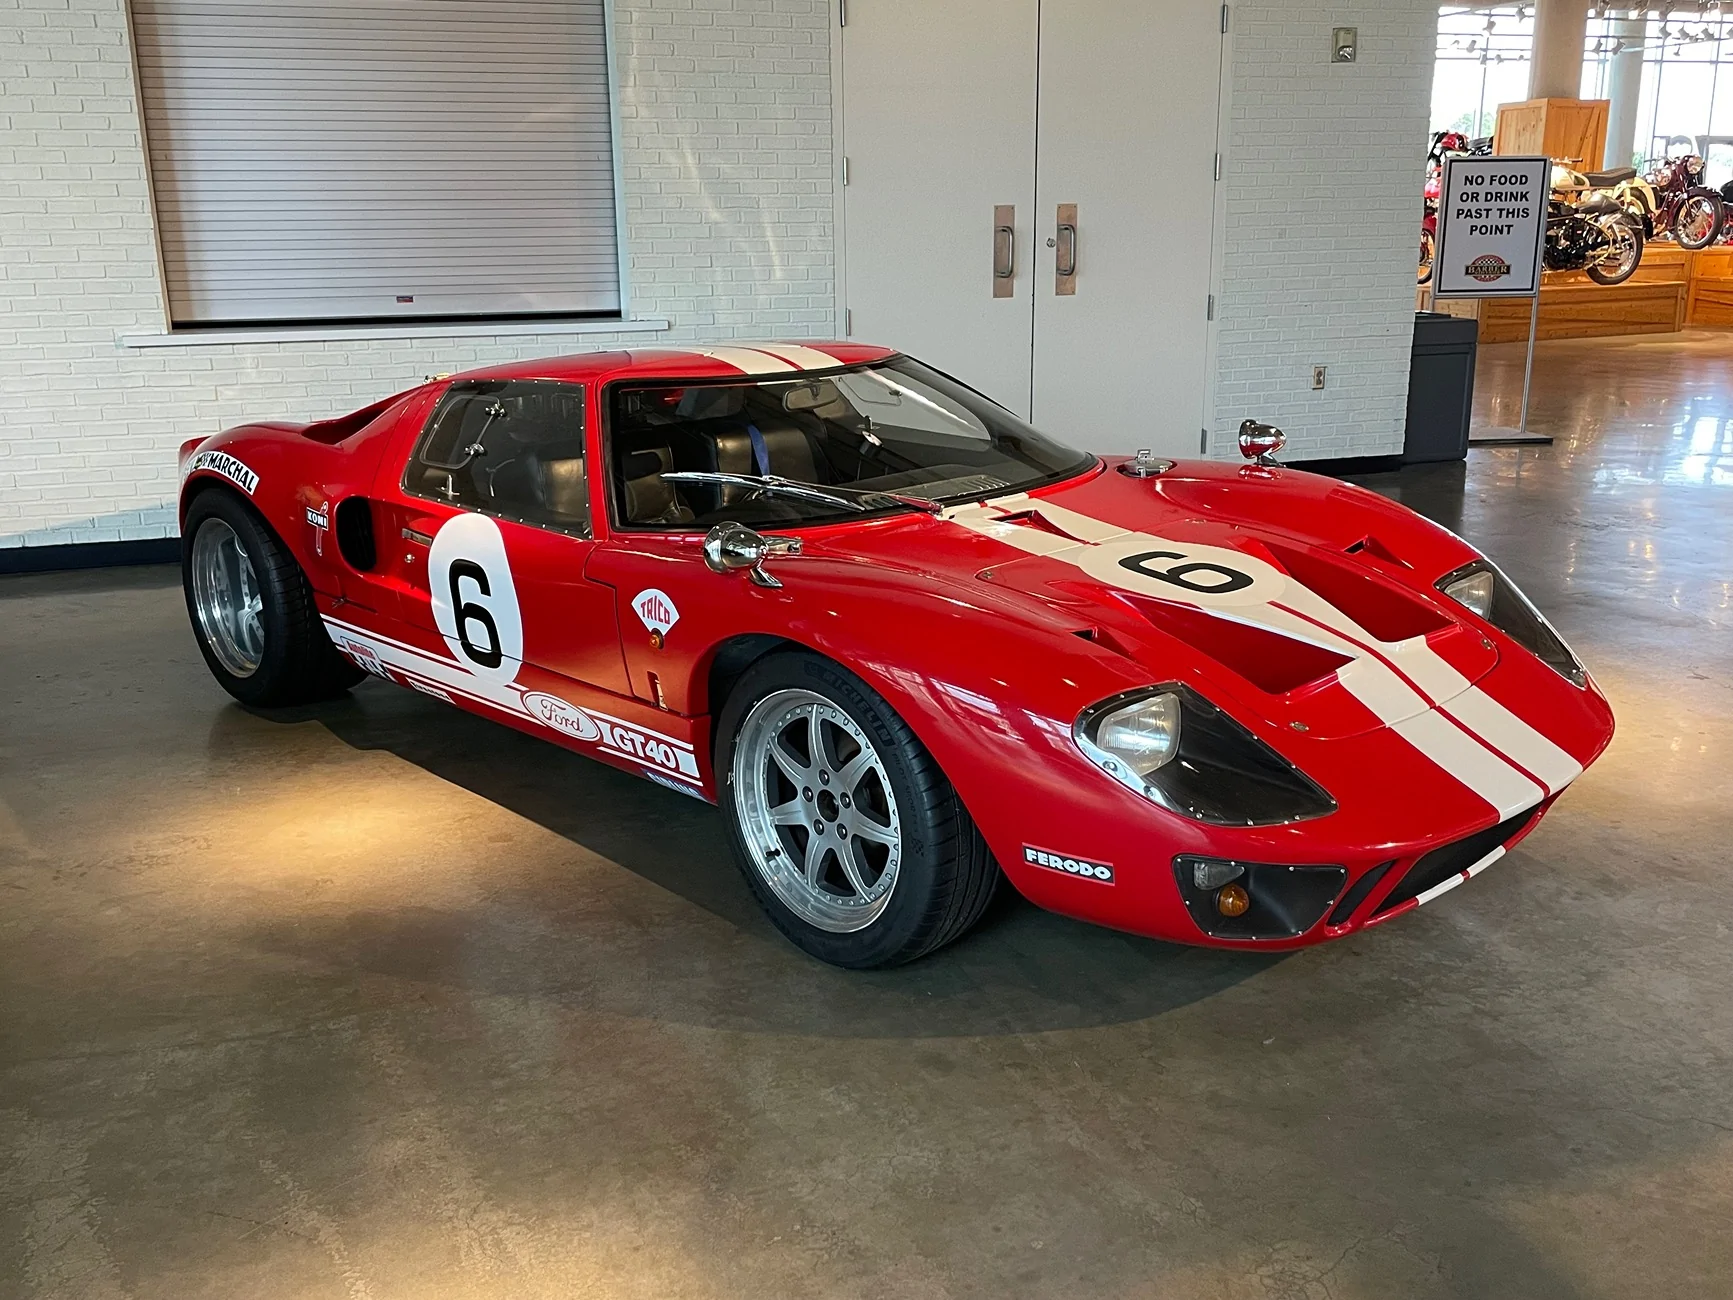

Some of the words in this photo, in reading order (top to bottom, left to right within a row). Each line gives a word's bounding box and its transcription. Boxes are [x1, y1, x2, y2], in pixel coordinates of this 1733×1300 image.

[1464, 175, 1484, 186] NO
[1489, 174, 1529, 186] FOOD
[1459, 192, 1480, 203] OR
[1484, 191, 1530, 202] DRINK
[1456, 208, 1492, 219] PAST
[1497, 208, 1530, 219] THIS
[1469, 224, 1514, 236] POINT
[1468, 265, 1508, 274] BARBER
[207, 453, 255, 492] MARCHAL
[307, 509, 327, 527] KONI
[1118, 551, 1254, 594] 6
[448, 558, 502, 669] 6
[640, 595, 671, 625] TRICO
[540, 699, 584, 733] Ford
[821, 670, 892, 742] MICHELIN
[613, 726, 677, 769] GT40
[891, 753, 908, 781] PILOT
[1025, 848, 1112, 880] FERODO
